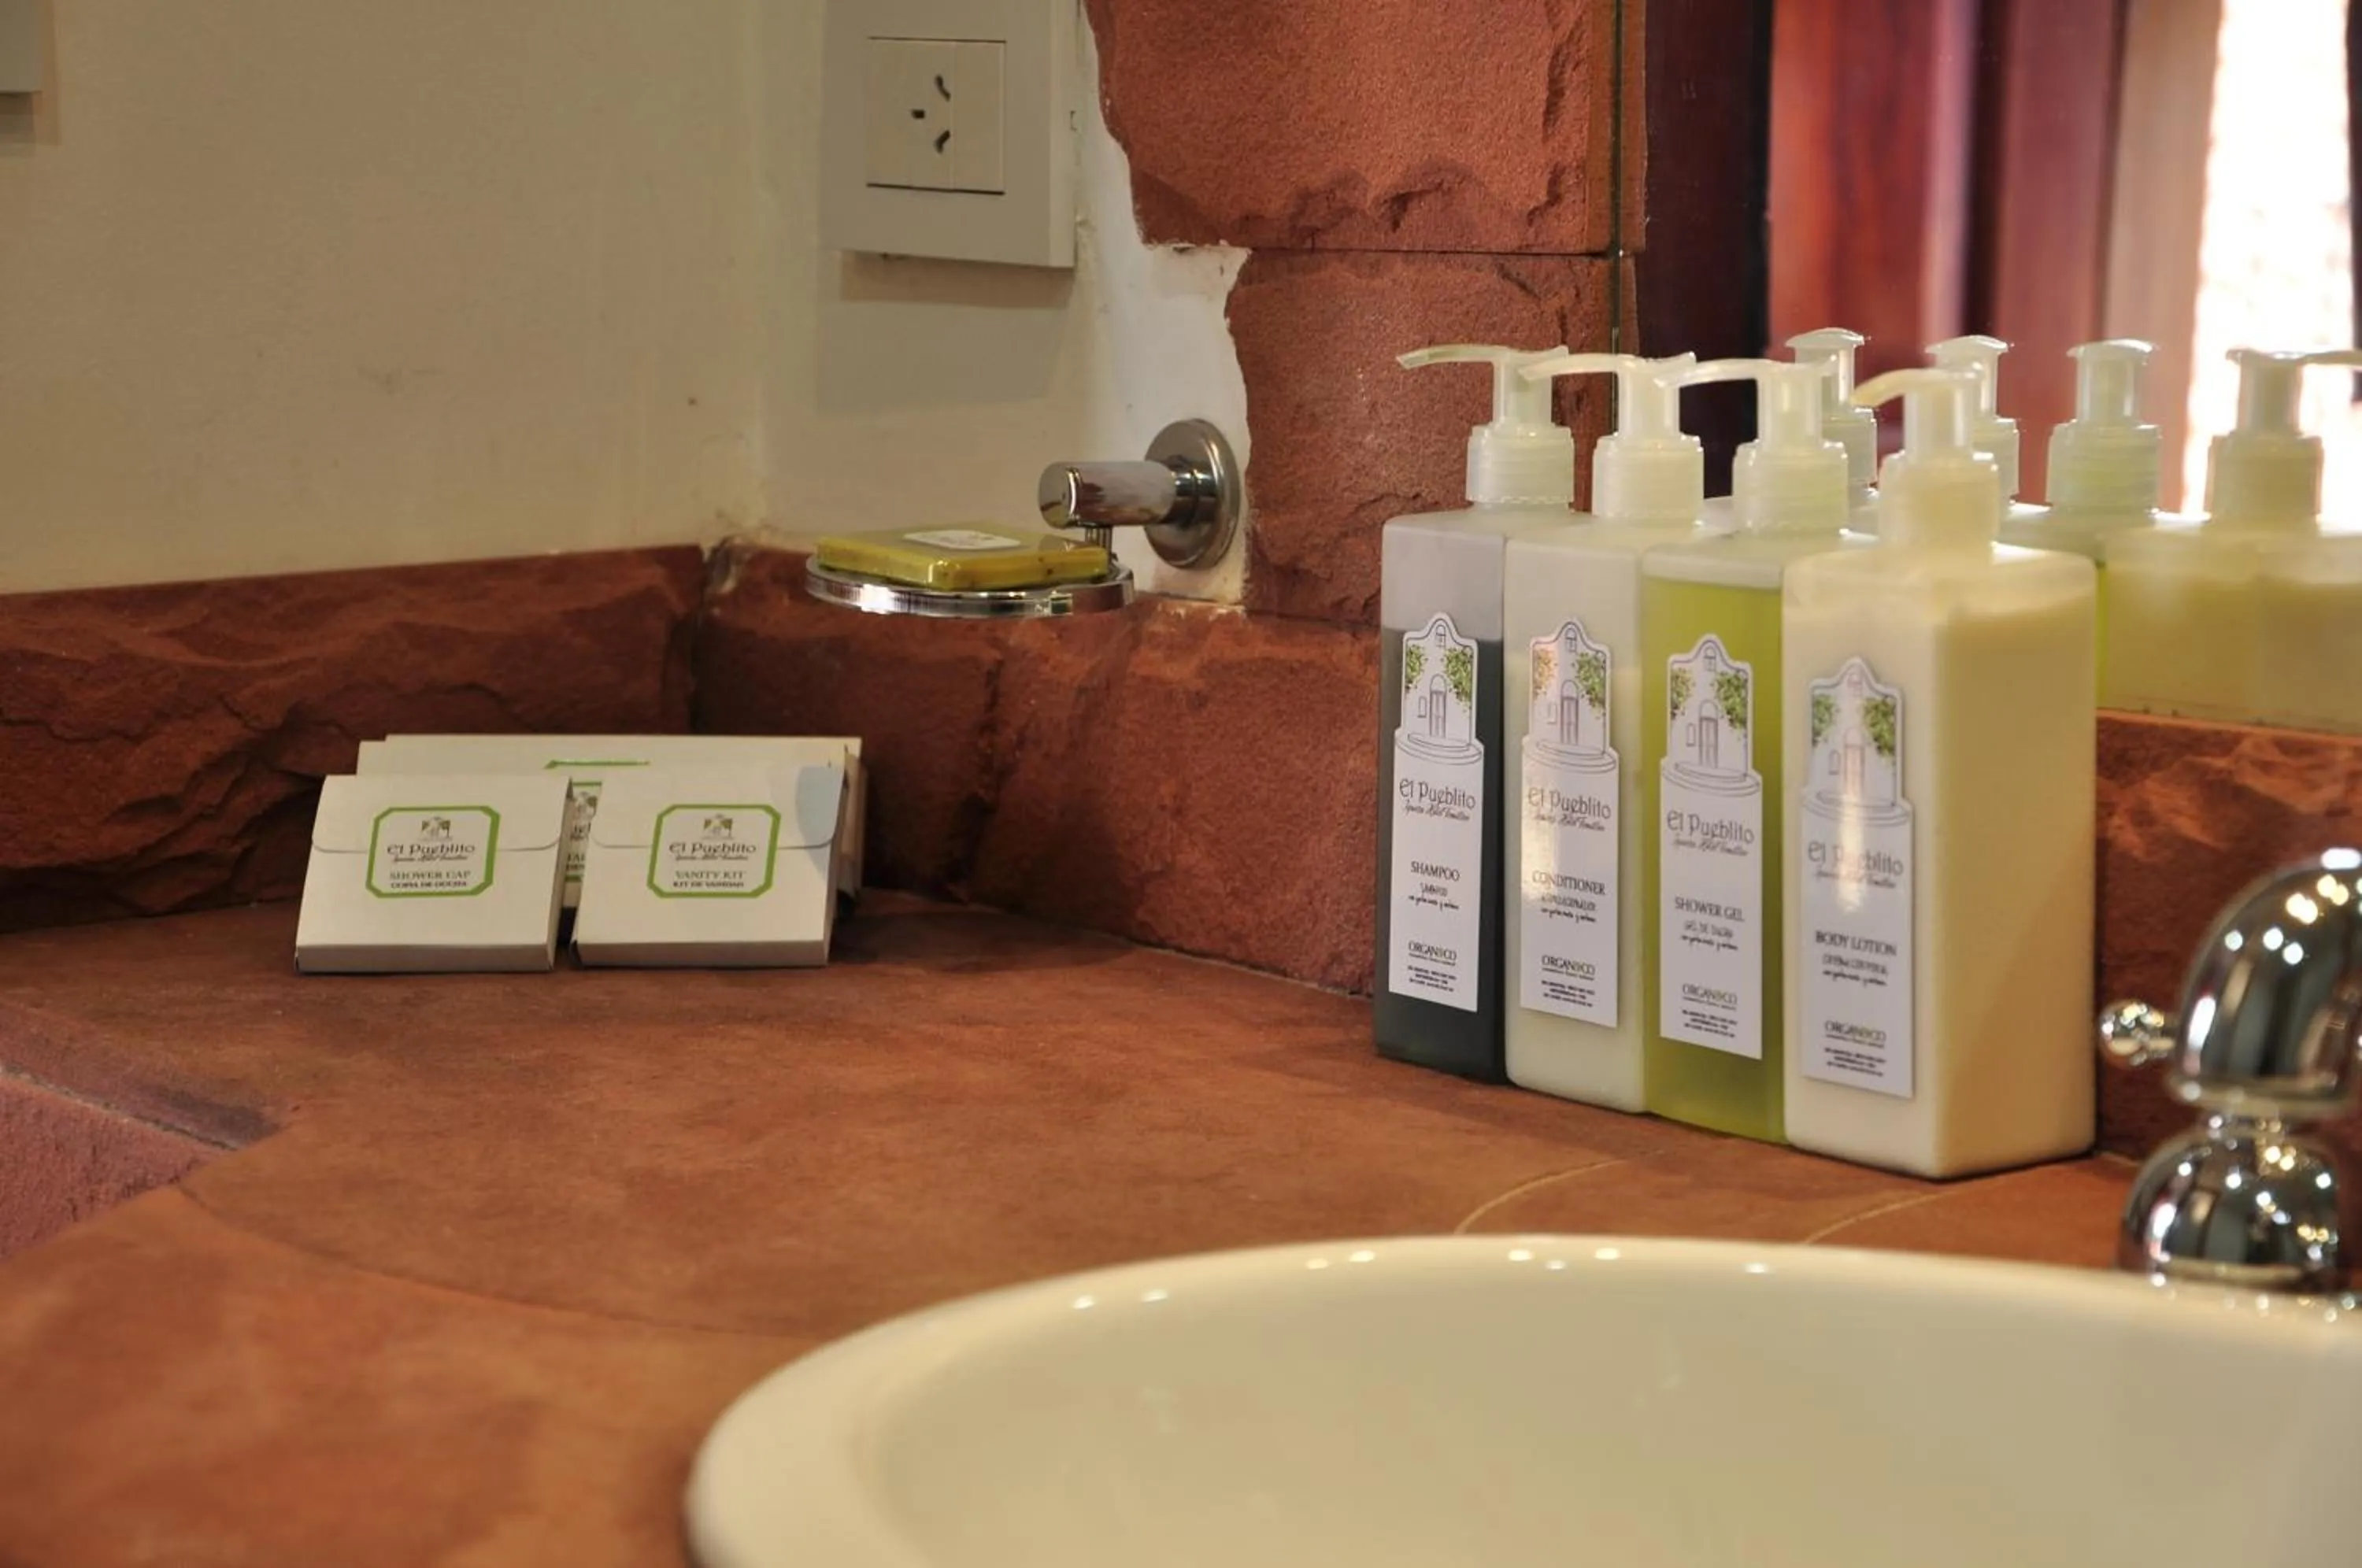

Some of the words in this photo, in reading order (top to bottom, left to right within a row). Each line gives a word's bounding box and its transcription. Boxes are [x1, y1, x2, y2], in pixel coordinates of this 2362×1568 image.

[1419, 780, 1476, 810] Pueblito
[1549, 789, 1612, 819] Pueblito
[1687, 812, 1755, 844] Pueblito
[409, 843, 476, 856] Pueblito
[691, 841, 757, 855] Pueblito
[1832, 843, 1904, 876] Pblito
[390, 870, 442, 880] SHOWER
[446, 869, 472, 879] CAP
[675, 870, 721, 880] VANITY
[723, 869, 746, 879] KIT
[1410, 860, 1461, 882] SHAMPOO
[1531, 870, 1605, 895] CONDITIONER
[1674, 895, 1722, 917] SHOWER
[1723, 906, 1745, 923] GEL
[1815, 930, 1849, 949] BODY
[1850, 936, 1897, 956] LOTION
